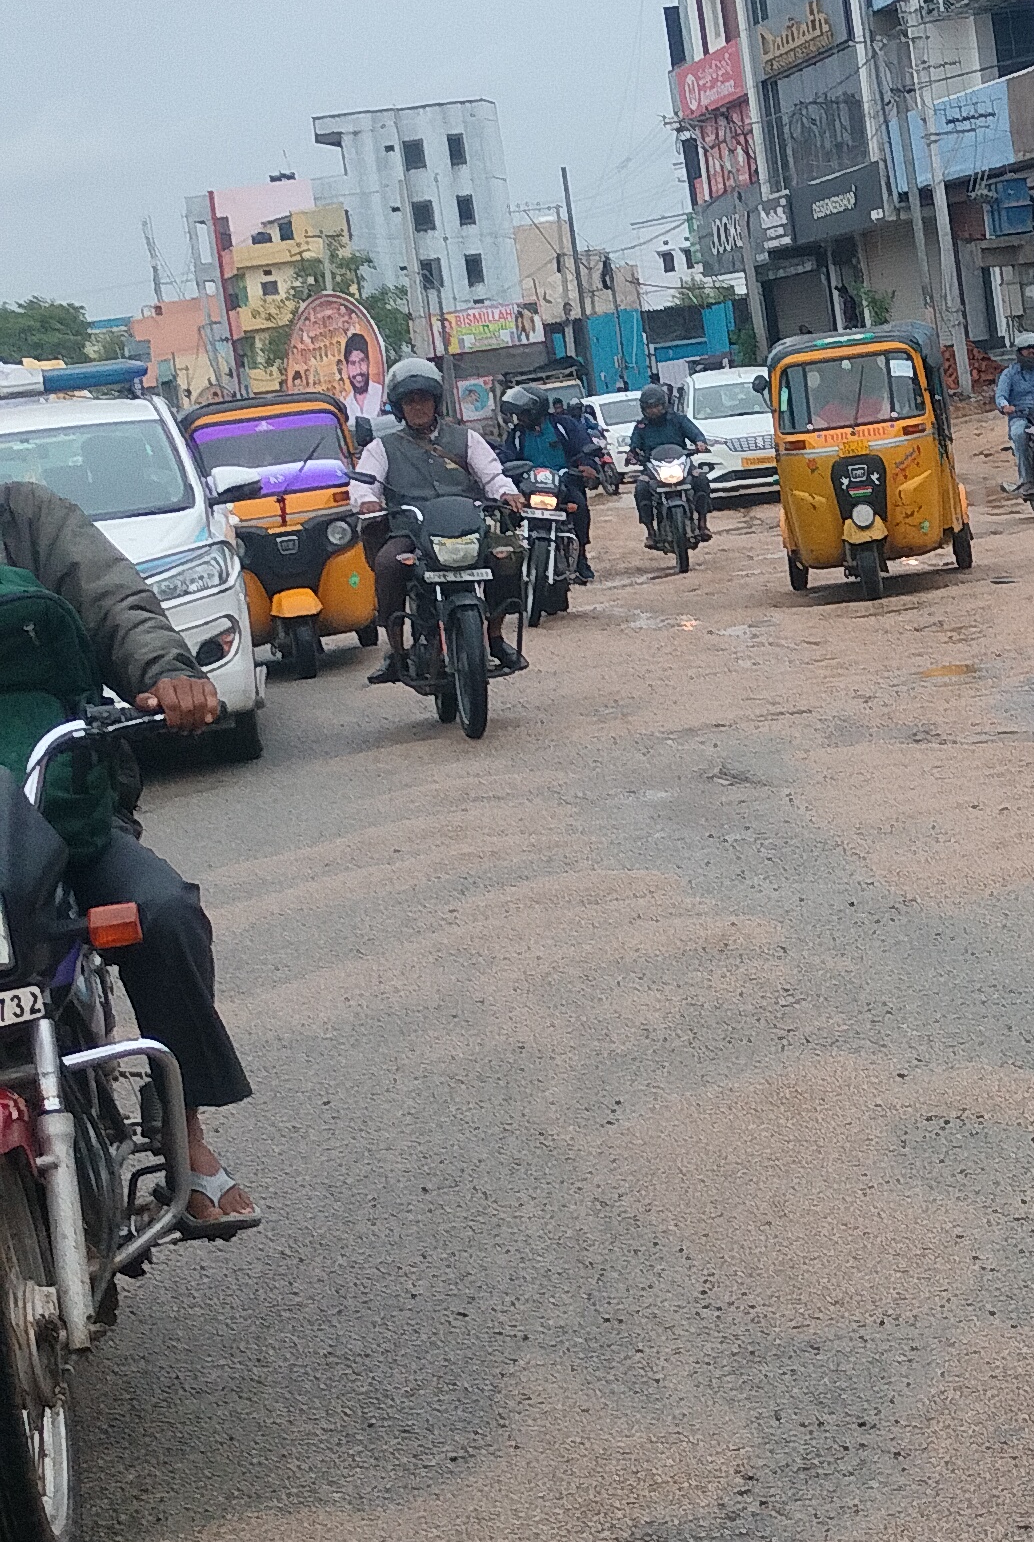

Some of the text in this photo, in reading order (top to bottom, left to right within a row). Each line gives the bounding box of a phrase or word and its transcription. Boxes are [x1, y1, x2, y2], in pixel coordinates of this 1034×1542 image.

[455, 308, 513, 327] BISMILLAH
[823, 425, 890, 444] FOR HIRE
